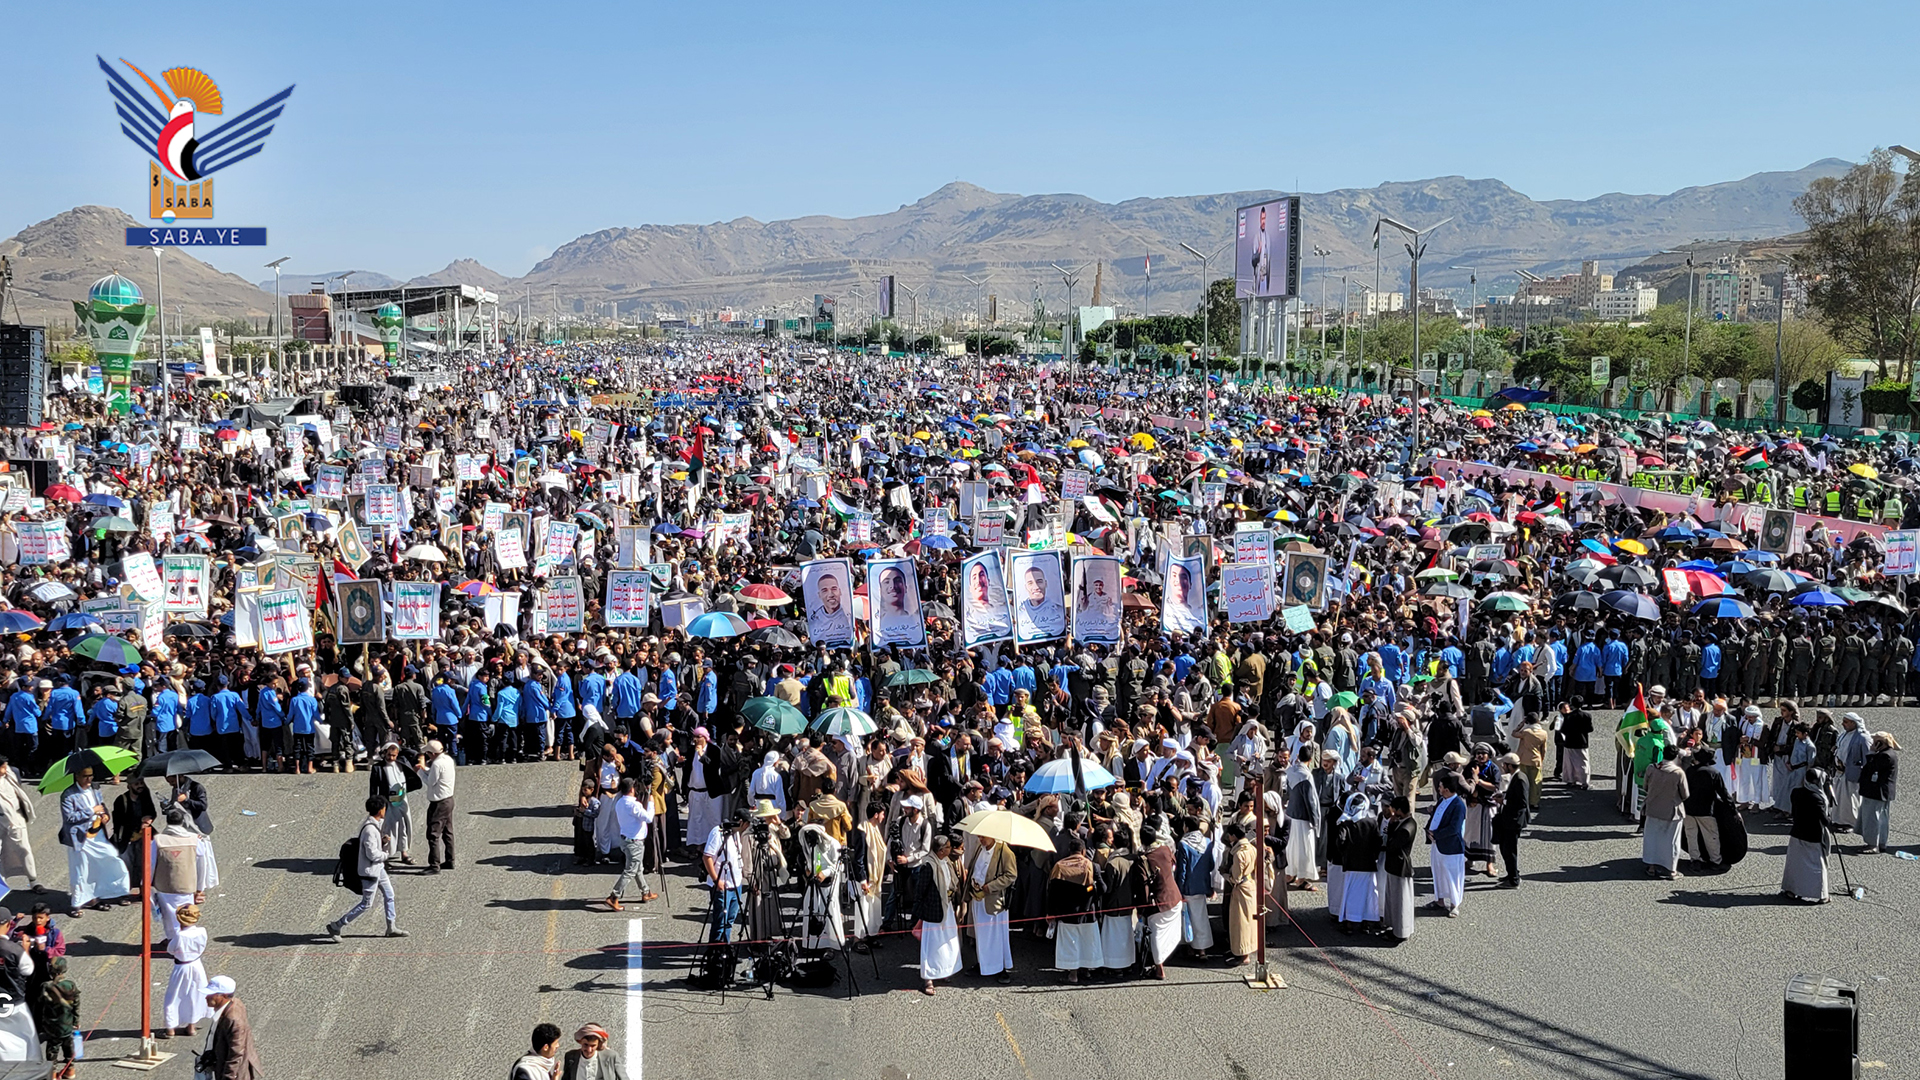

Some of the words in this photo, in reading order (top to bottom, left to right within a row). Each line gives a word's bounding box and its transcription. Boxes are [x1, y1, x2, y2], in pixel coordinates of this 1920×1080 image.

[614, 574, 634, 586] أكبر
[634, 576, 648, 584] الله
[1228, 570, 1240, 586] على
[564, 580, 576, 590] الله
[1234, 604, 1262, 618] النصر
